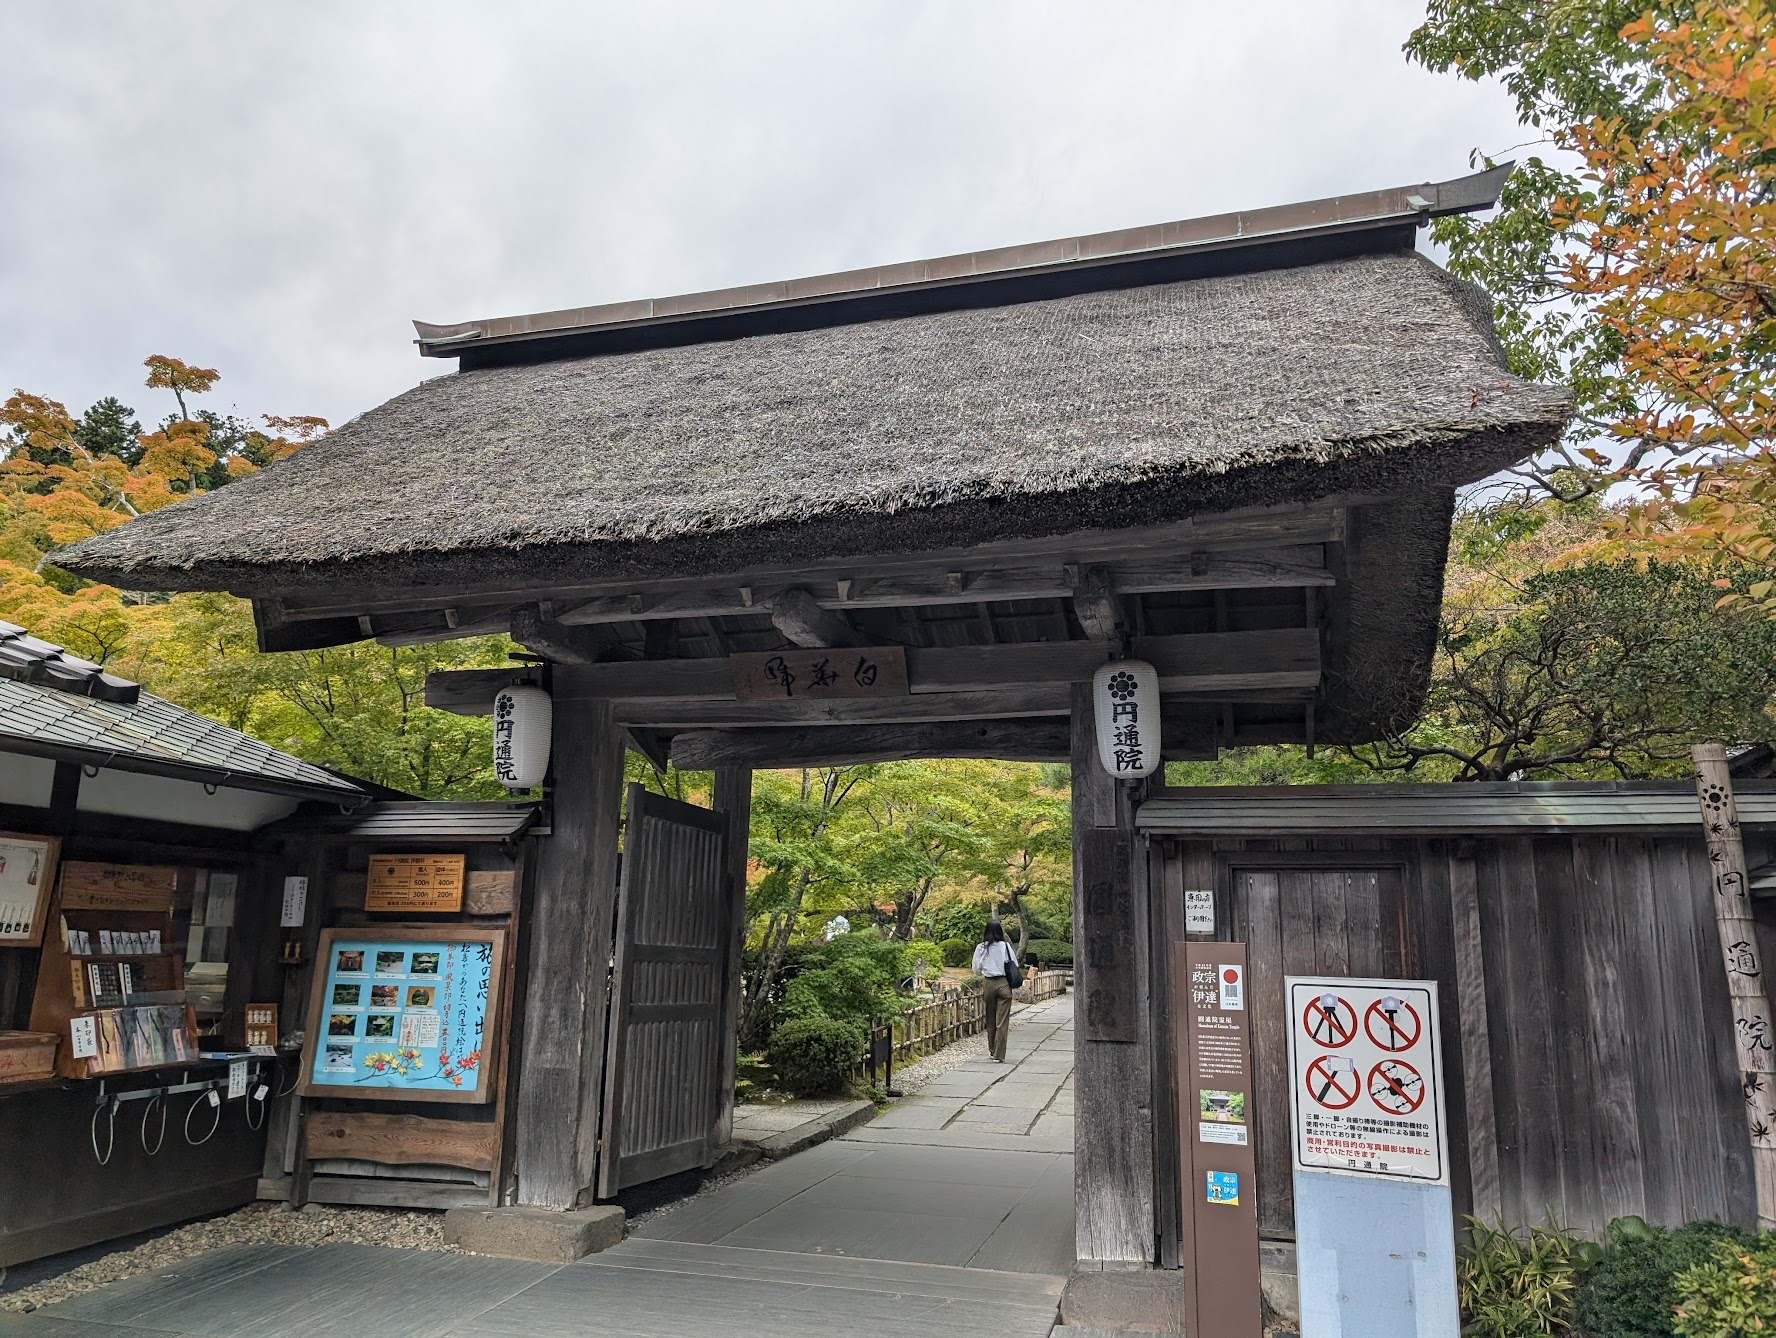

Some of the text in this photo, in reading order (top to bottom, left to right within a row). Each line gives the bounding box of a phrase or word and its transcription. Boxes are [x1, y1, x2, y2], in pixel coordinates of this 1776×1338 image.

[495, 719, 518, 781] 円通院
[1112, 701, 1144, 772] 円通院
[1192, 971, 1216, 983] 政宗
[1716, 871, 1773, 1051] 円通院
[1306, 1128, 1367, 1140] 禁止されております。
[1307, 1146, 1381, 1159] させていただきます。
